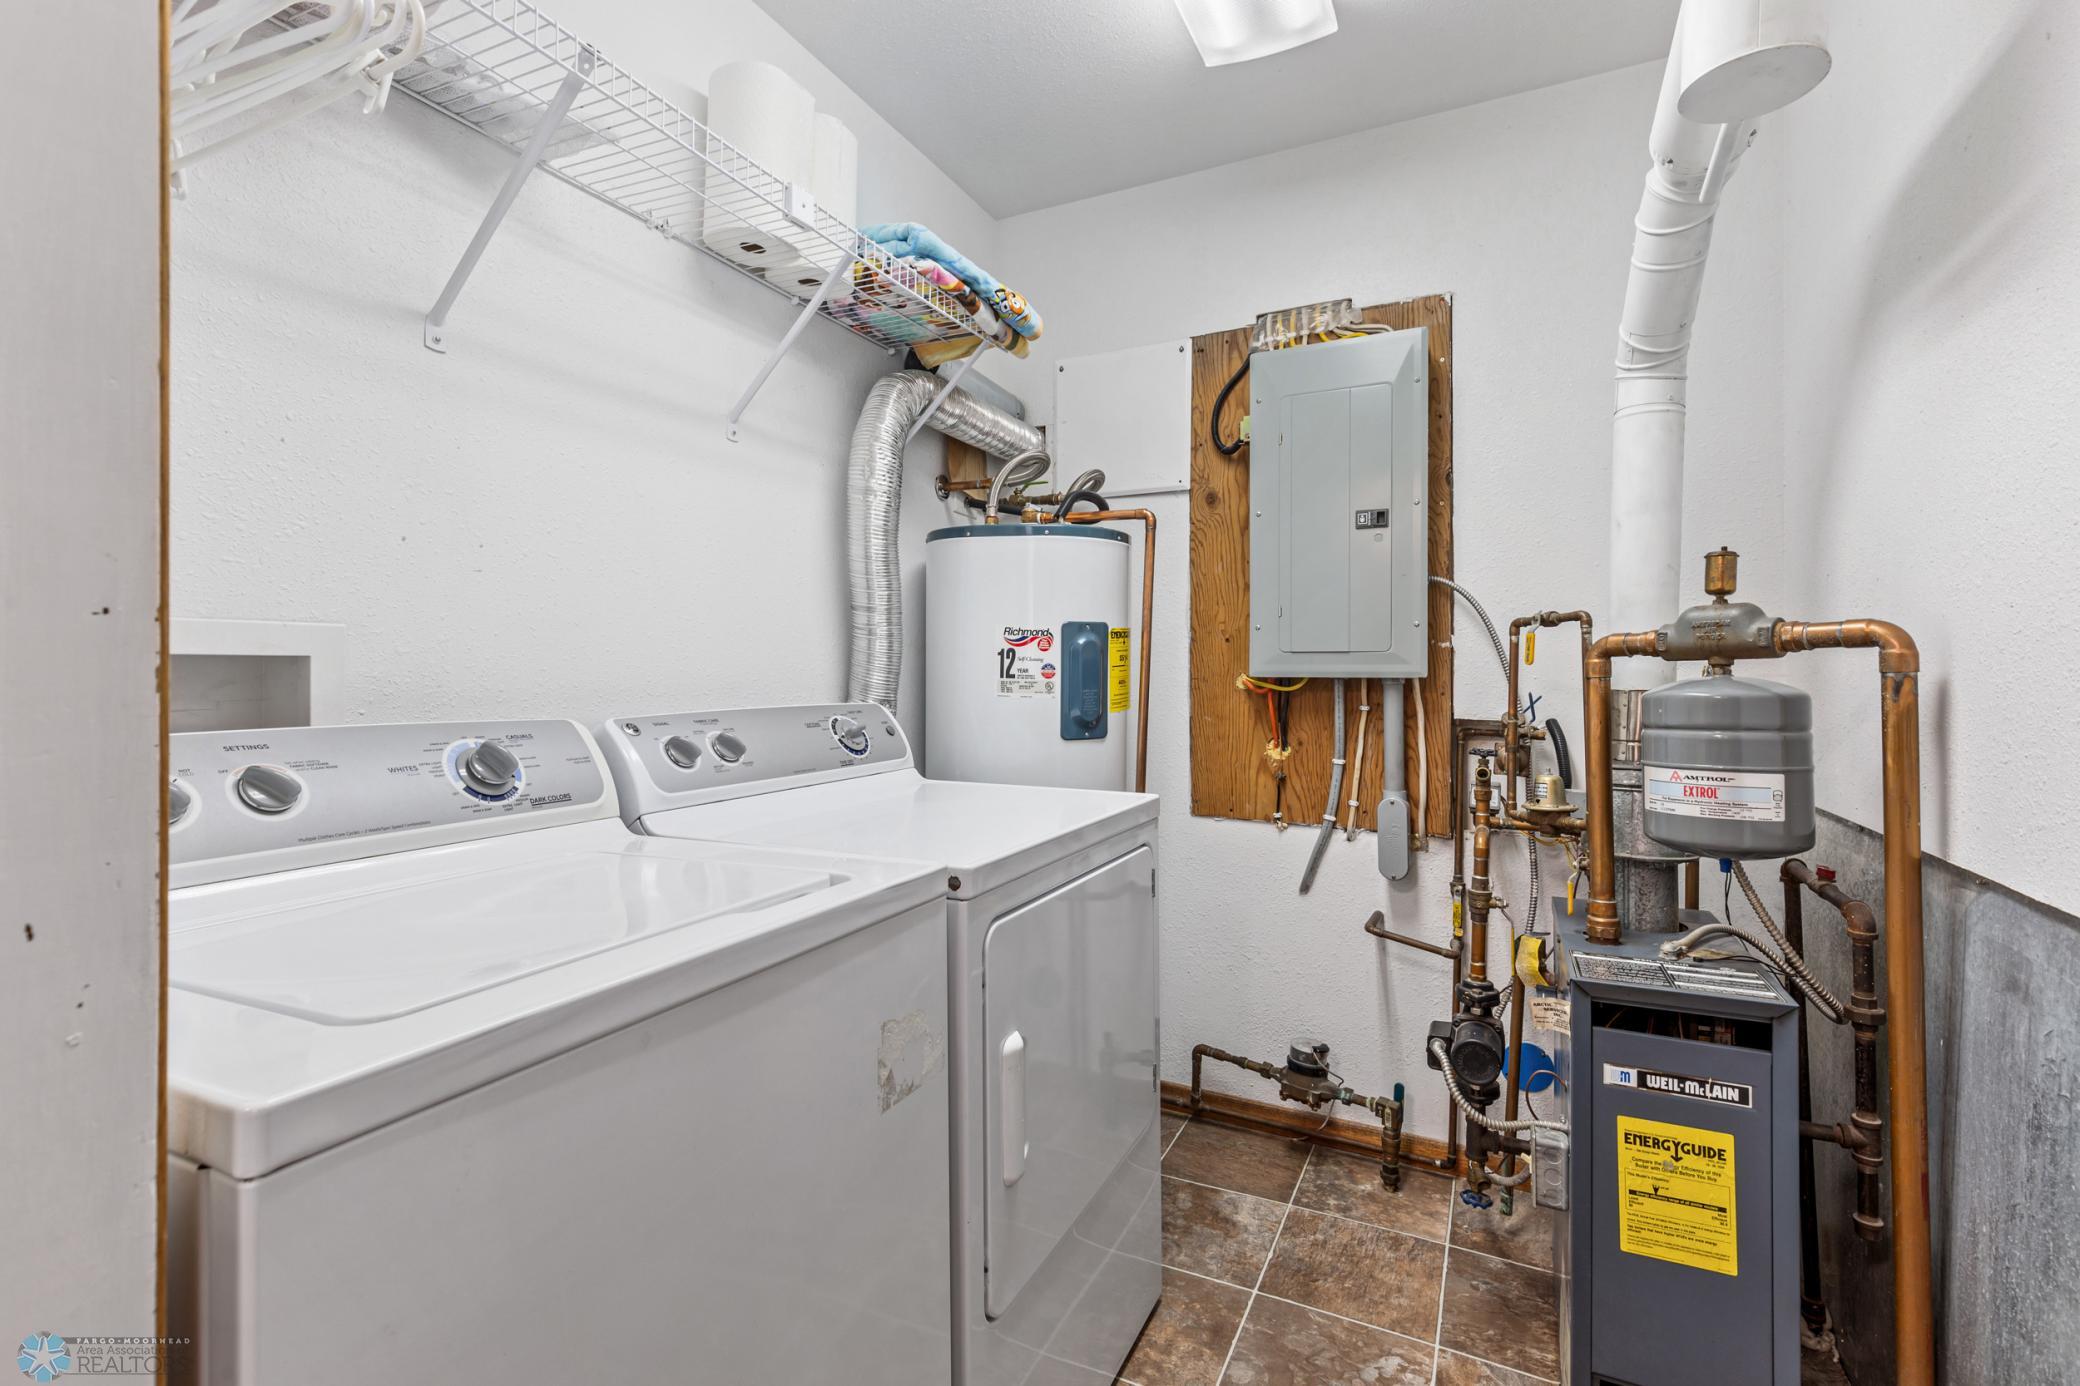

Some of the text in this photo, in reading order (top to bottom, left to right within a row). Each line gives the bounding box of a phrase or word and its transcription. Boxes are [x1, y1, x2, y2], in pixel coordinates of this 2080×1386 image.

[1003, 627, 1050, 637] Richmond
[997, 648, 1016, 679] 12
[222, 743, 270, 752] SETTINGS
[387, 765, 418, 773] WHITES
[1683, 774, 1730, 783] AMTROL
[1683, 785, 1718, 799] EXTROL
[529, 796, 547, 804] DARK
[547, 793, 572, 802] COLORS
[1646, 1074, 1740, 1102] WEIL-McLAIN
[1624, 1132, 1727, 1162] ENERGYGUIDE
